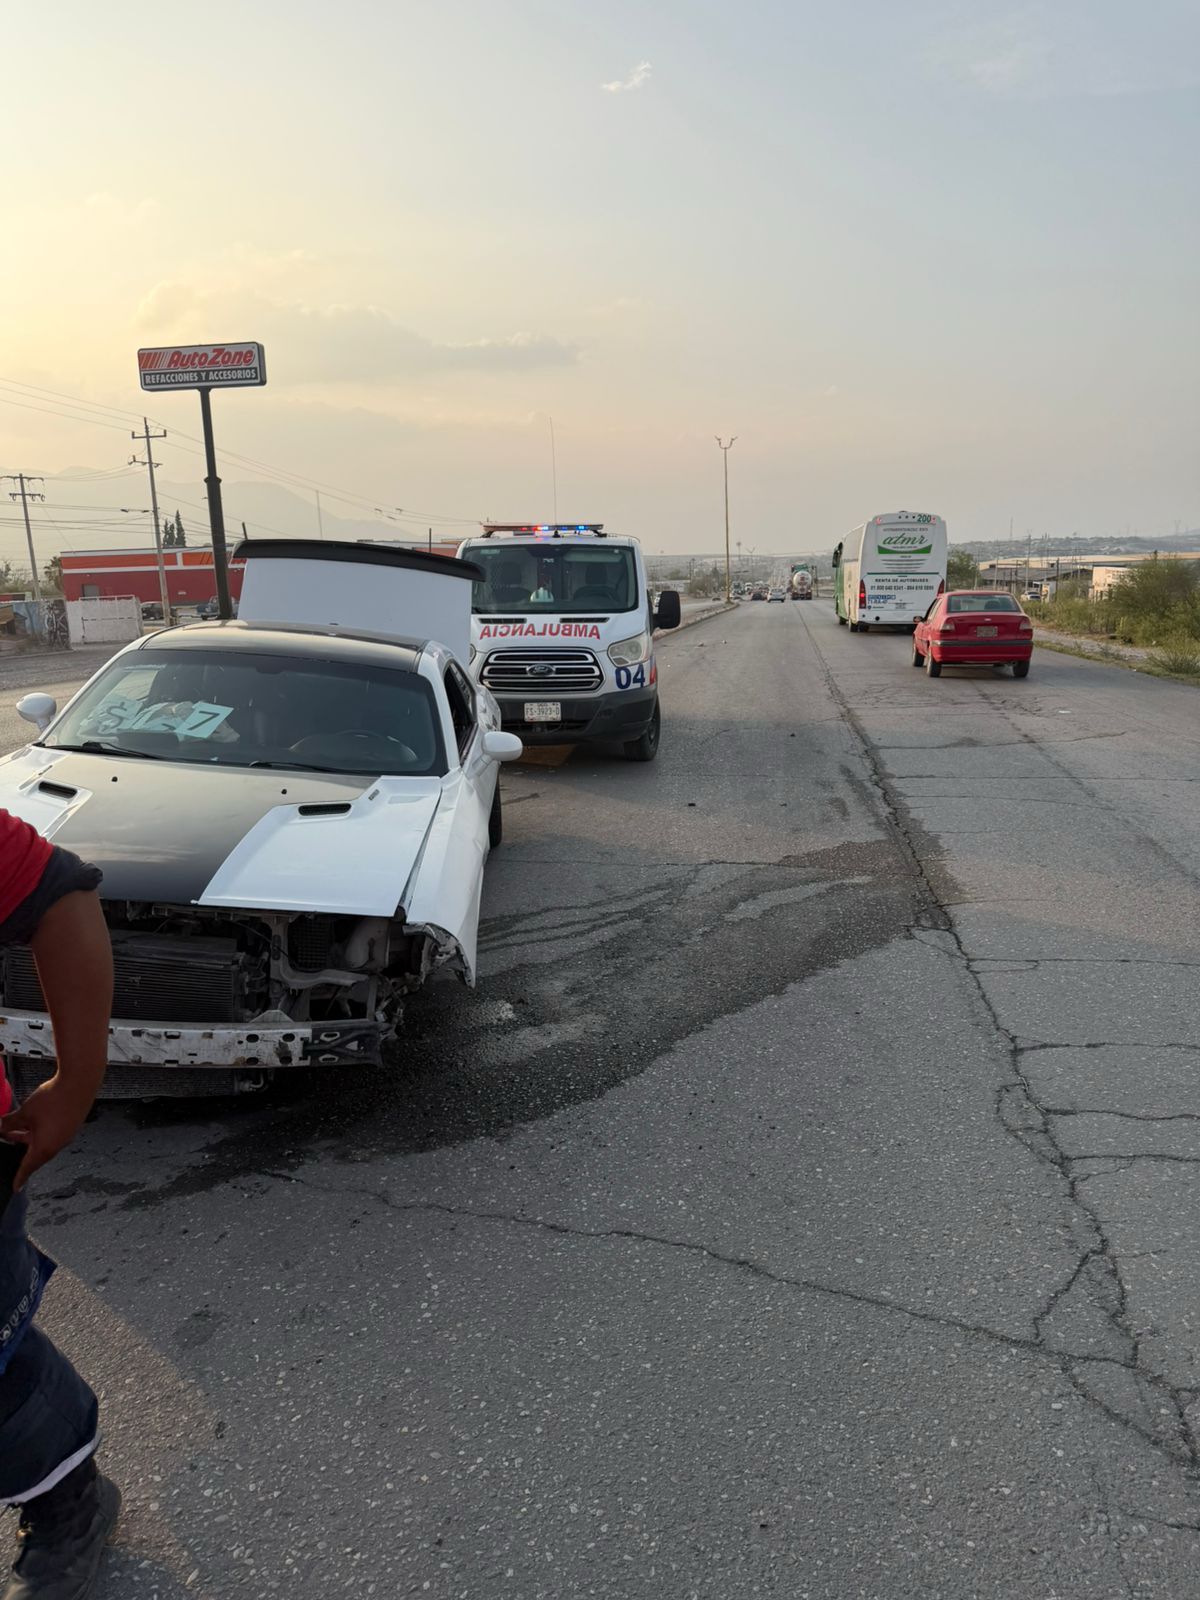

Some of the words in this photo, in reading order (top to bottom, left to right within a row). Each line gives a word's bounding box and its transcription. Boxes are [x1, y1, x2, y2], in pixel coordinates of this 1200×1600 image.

[167, 348, 255, 370] AutoZone
[145, 373, 198, 384] REFACCIONES
[199, 372, 206, 381] Y
[208, 369, 256, 381] ACCESORIOS
[917, 514, 932, 523] 200
[615, 663, 646, 689] 04
